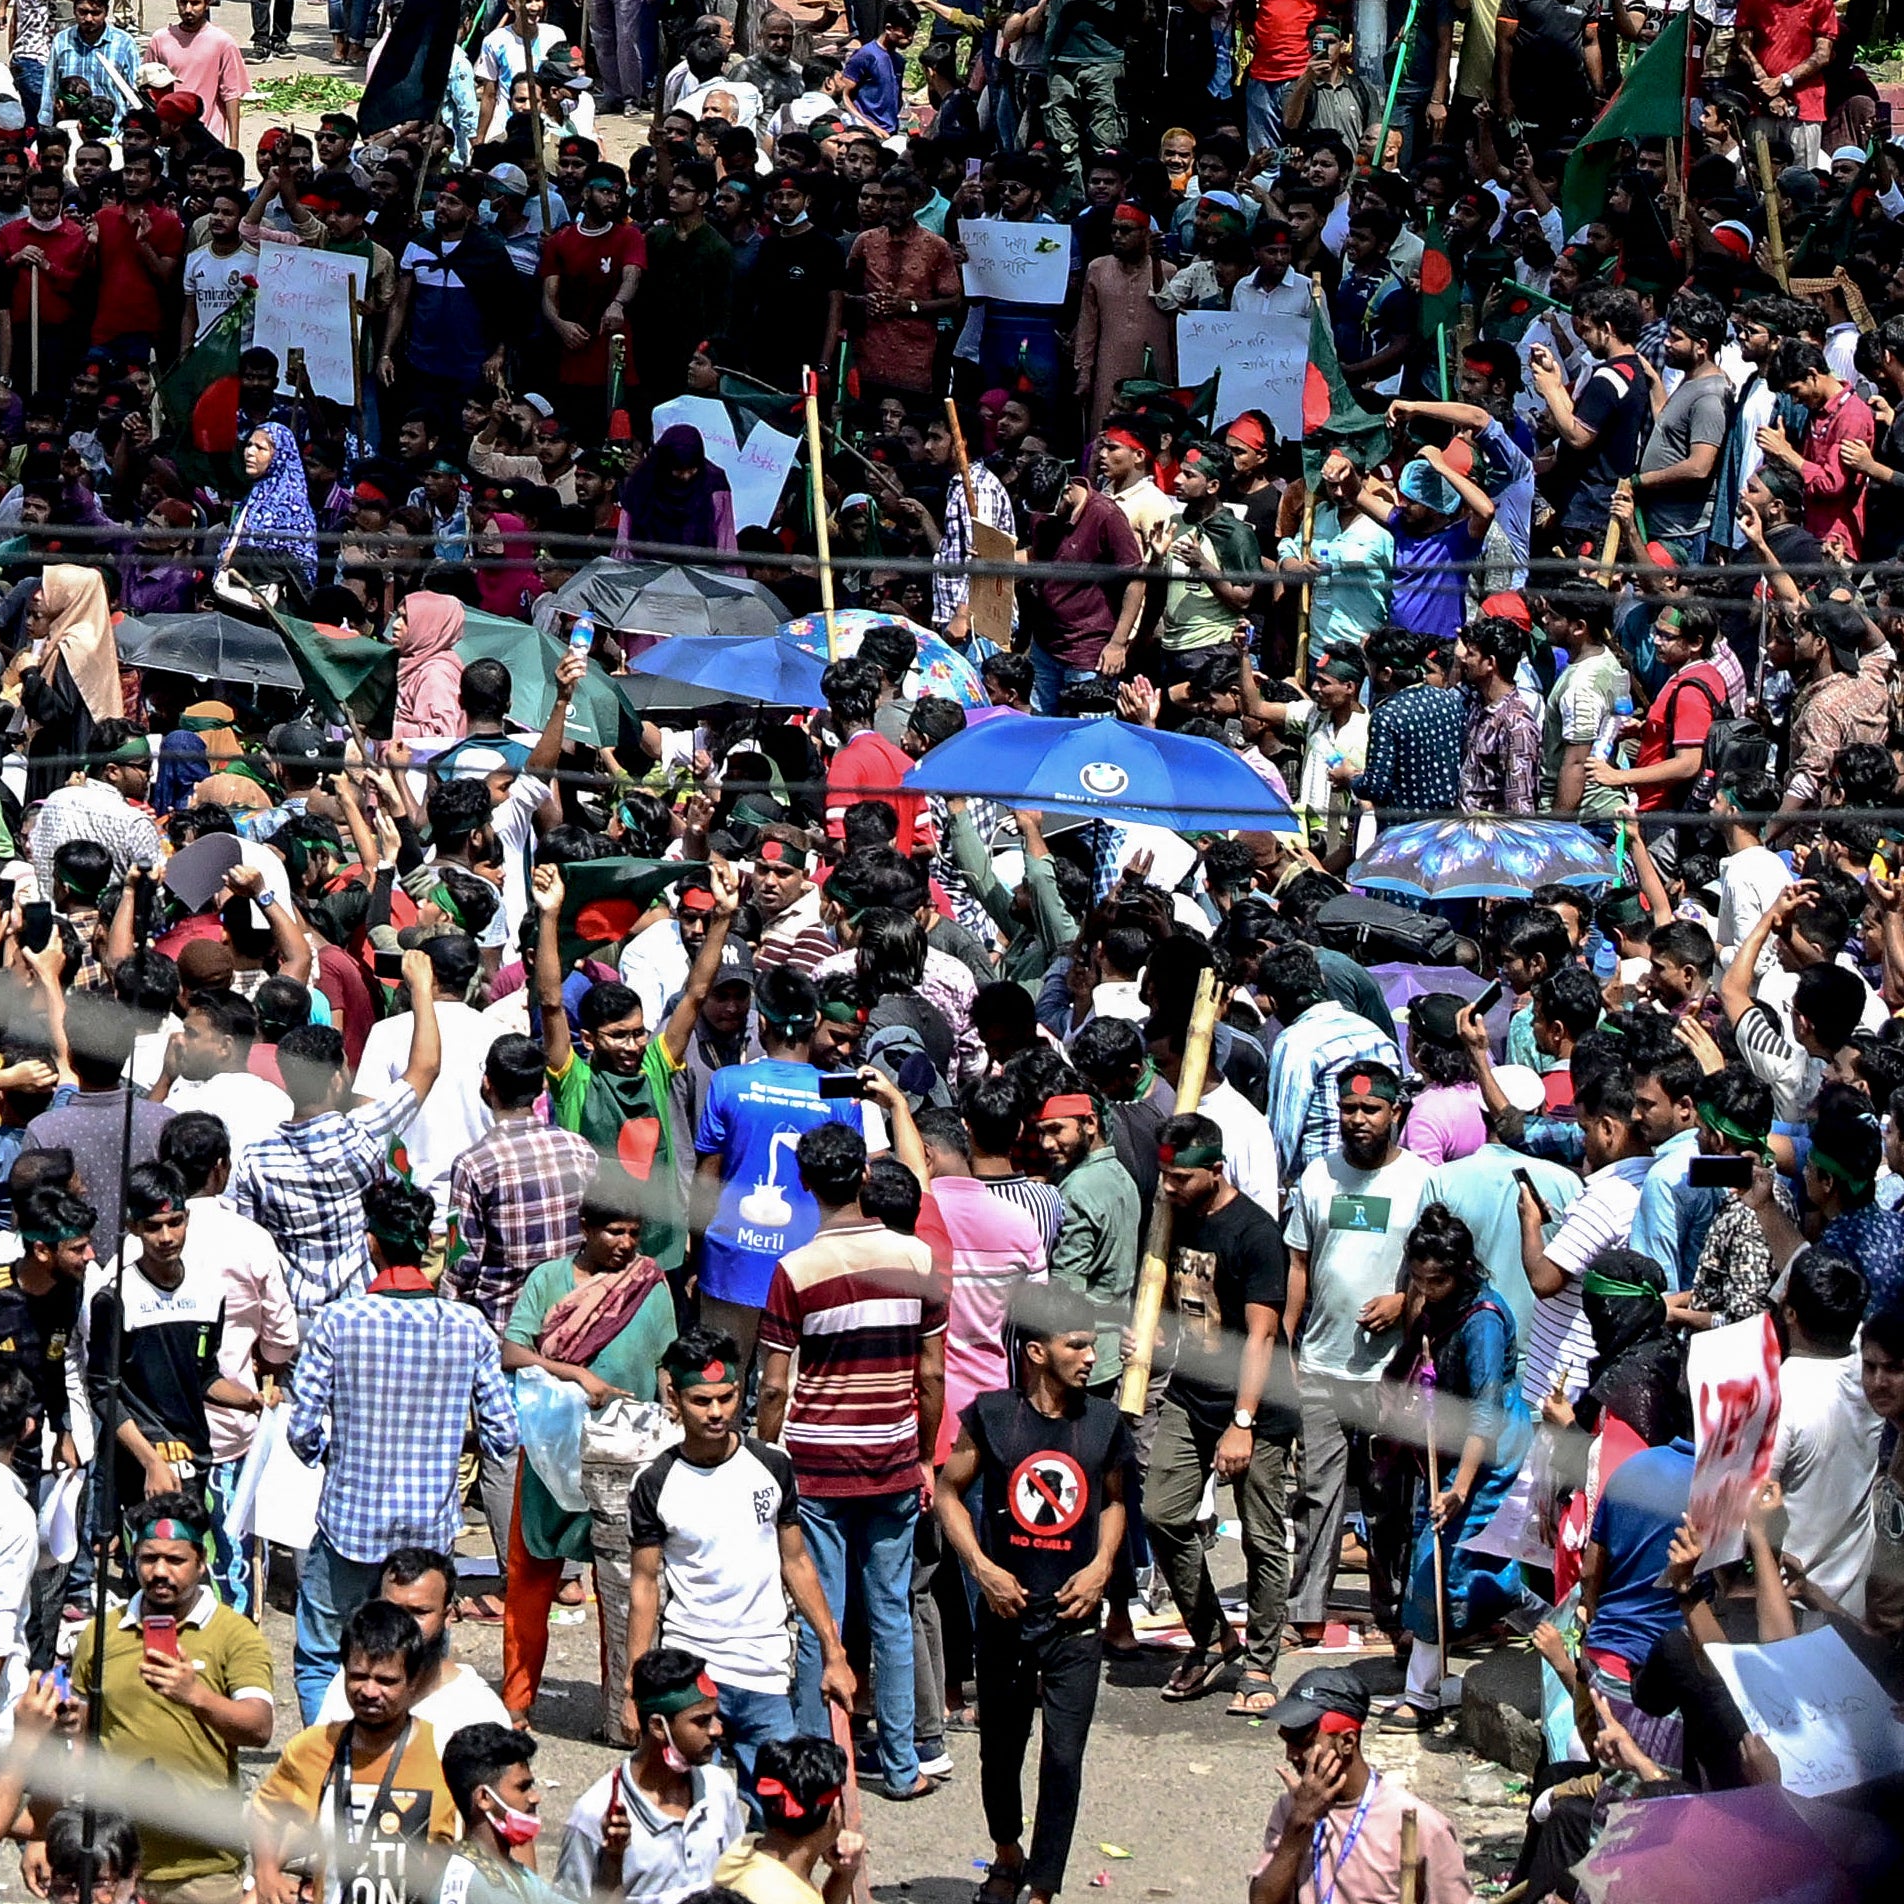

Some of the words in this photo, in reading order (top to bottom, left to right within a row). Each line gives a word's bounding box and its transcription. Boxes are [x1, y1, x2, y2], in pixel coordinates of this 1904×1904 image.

[737, 1227, 783, 1249] Meril
[753, 1486, 775, 1500] JUST
[753, 1499, 770, 1512] DO
[1009, 1533, 1028, 1547] NO
